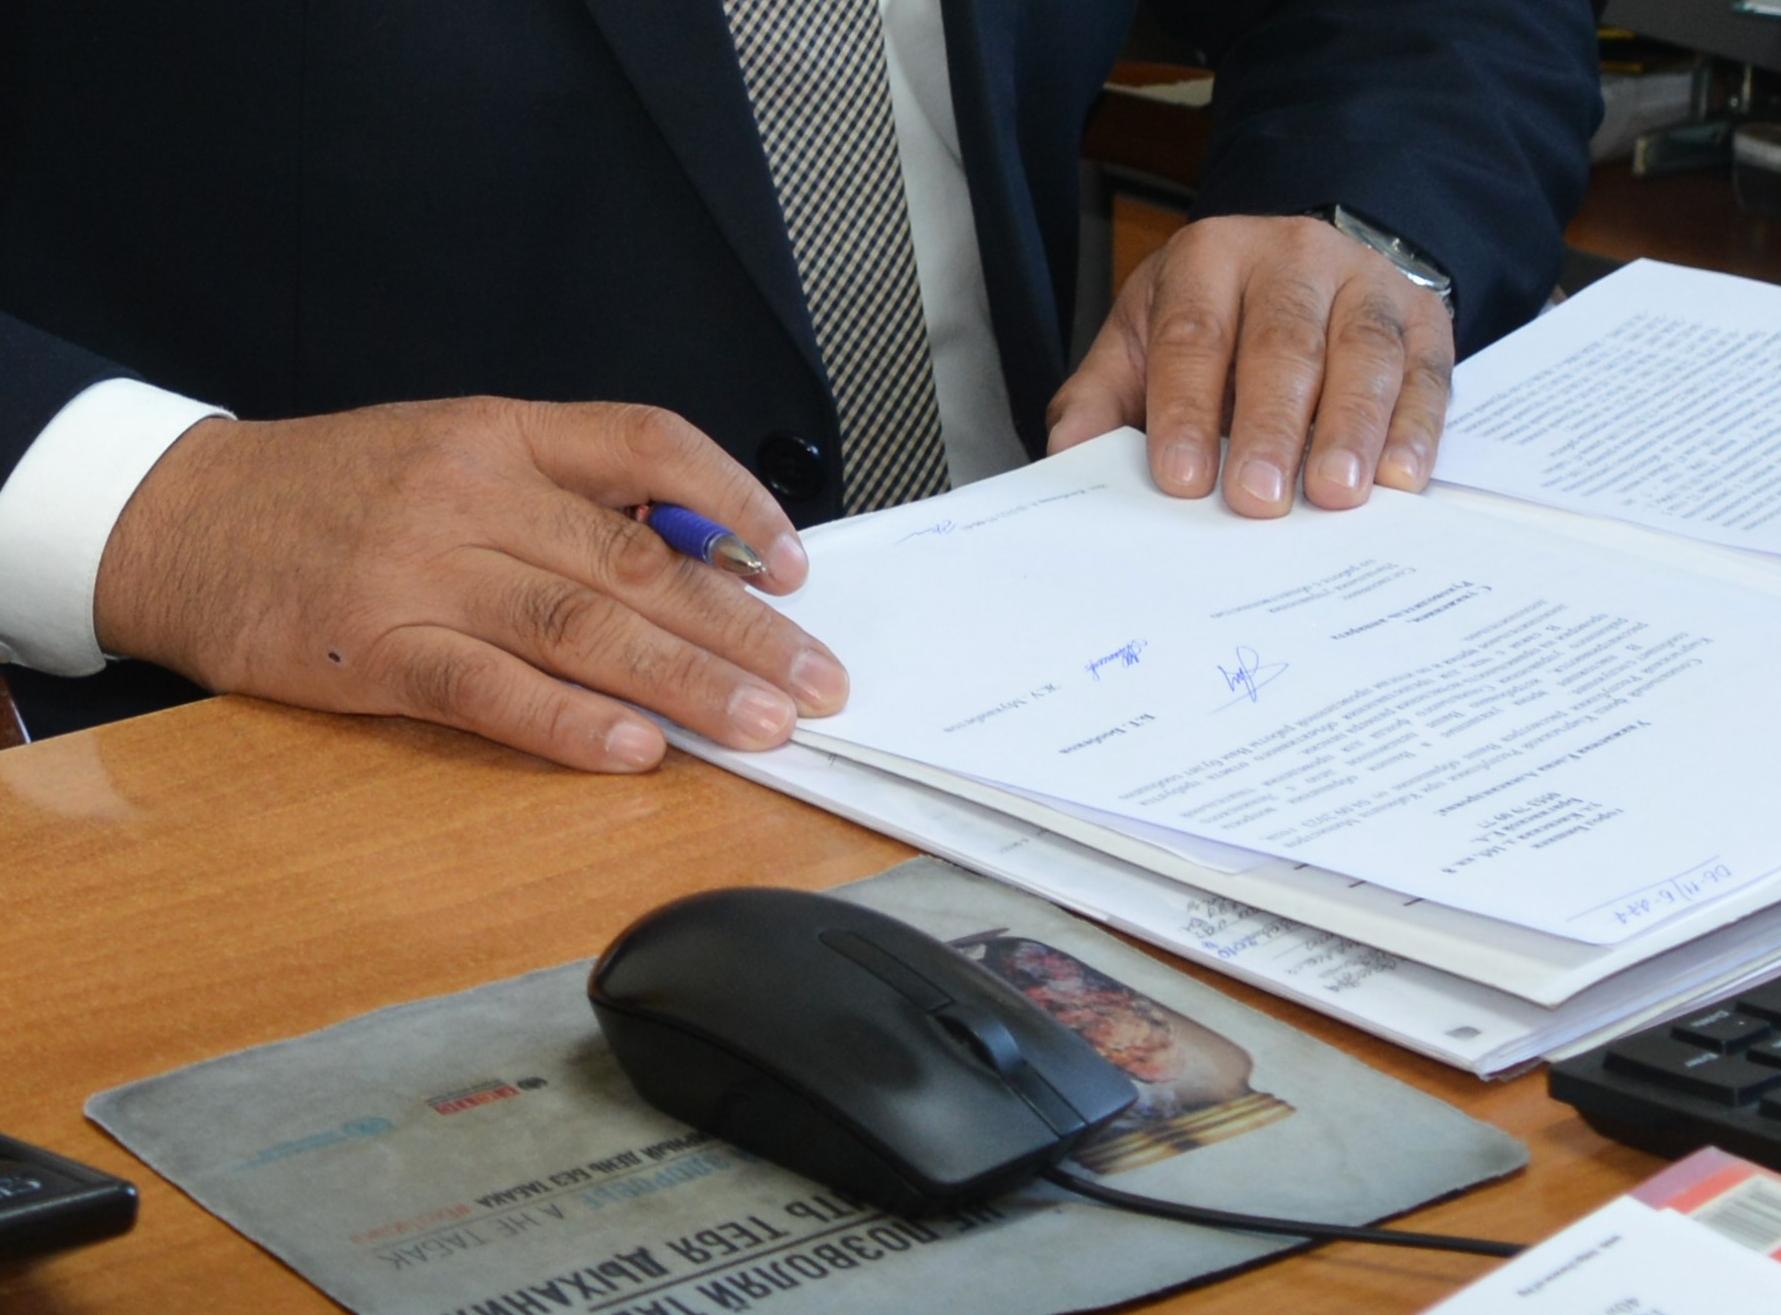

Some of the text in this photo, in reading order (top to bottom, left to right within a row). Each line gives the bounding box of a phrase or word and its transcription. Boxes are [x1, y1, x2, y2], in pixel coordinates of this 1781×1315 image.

[1626, 658, 1702, 697] Социальный
[1593, 697, 1628, 714] фонд
[1437, 720, 1650, 816] Уважаемая Елена Александровна!
[1446, 748, 1523, 781] Республики
[1357, 792, 1422, 817] Кабинете
[1474, 830, 1505, 841] Е.А.
[1477, 820, 1497, 828] 77
[1516, 812, 1584, 839] Киевская
[1531, 808, 1623, 848] город Бишкек
[1690, 1009, 1728, 1027] Delete
[1684, 1052, 1717, 1067] Enter
[546, 1166, 582, 1189] БЕЗ
[584, 1151, 639, 1177] ДЕНЬ
[474, 1180, 544, 1210] ТАБАКА
[379, 1152, 734, 1272] ЗДОРОВЬЕ А НЕ ТАБАК
[667, 1215, 791, 1266] ТЕБЯ
[696, 1219, 944, 1312] ПОЗВОЛЯЙ
[450, 1247, 670, 1315] ДЫХАНИ
